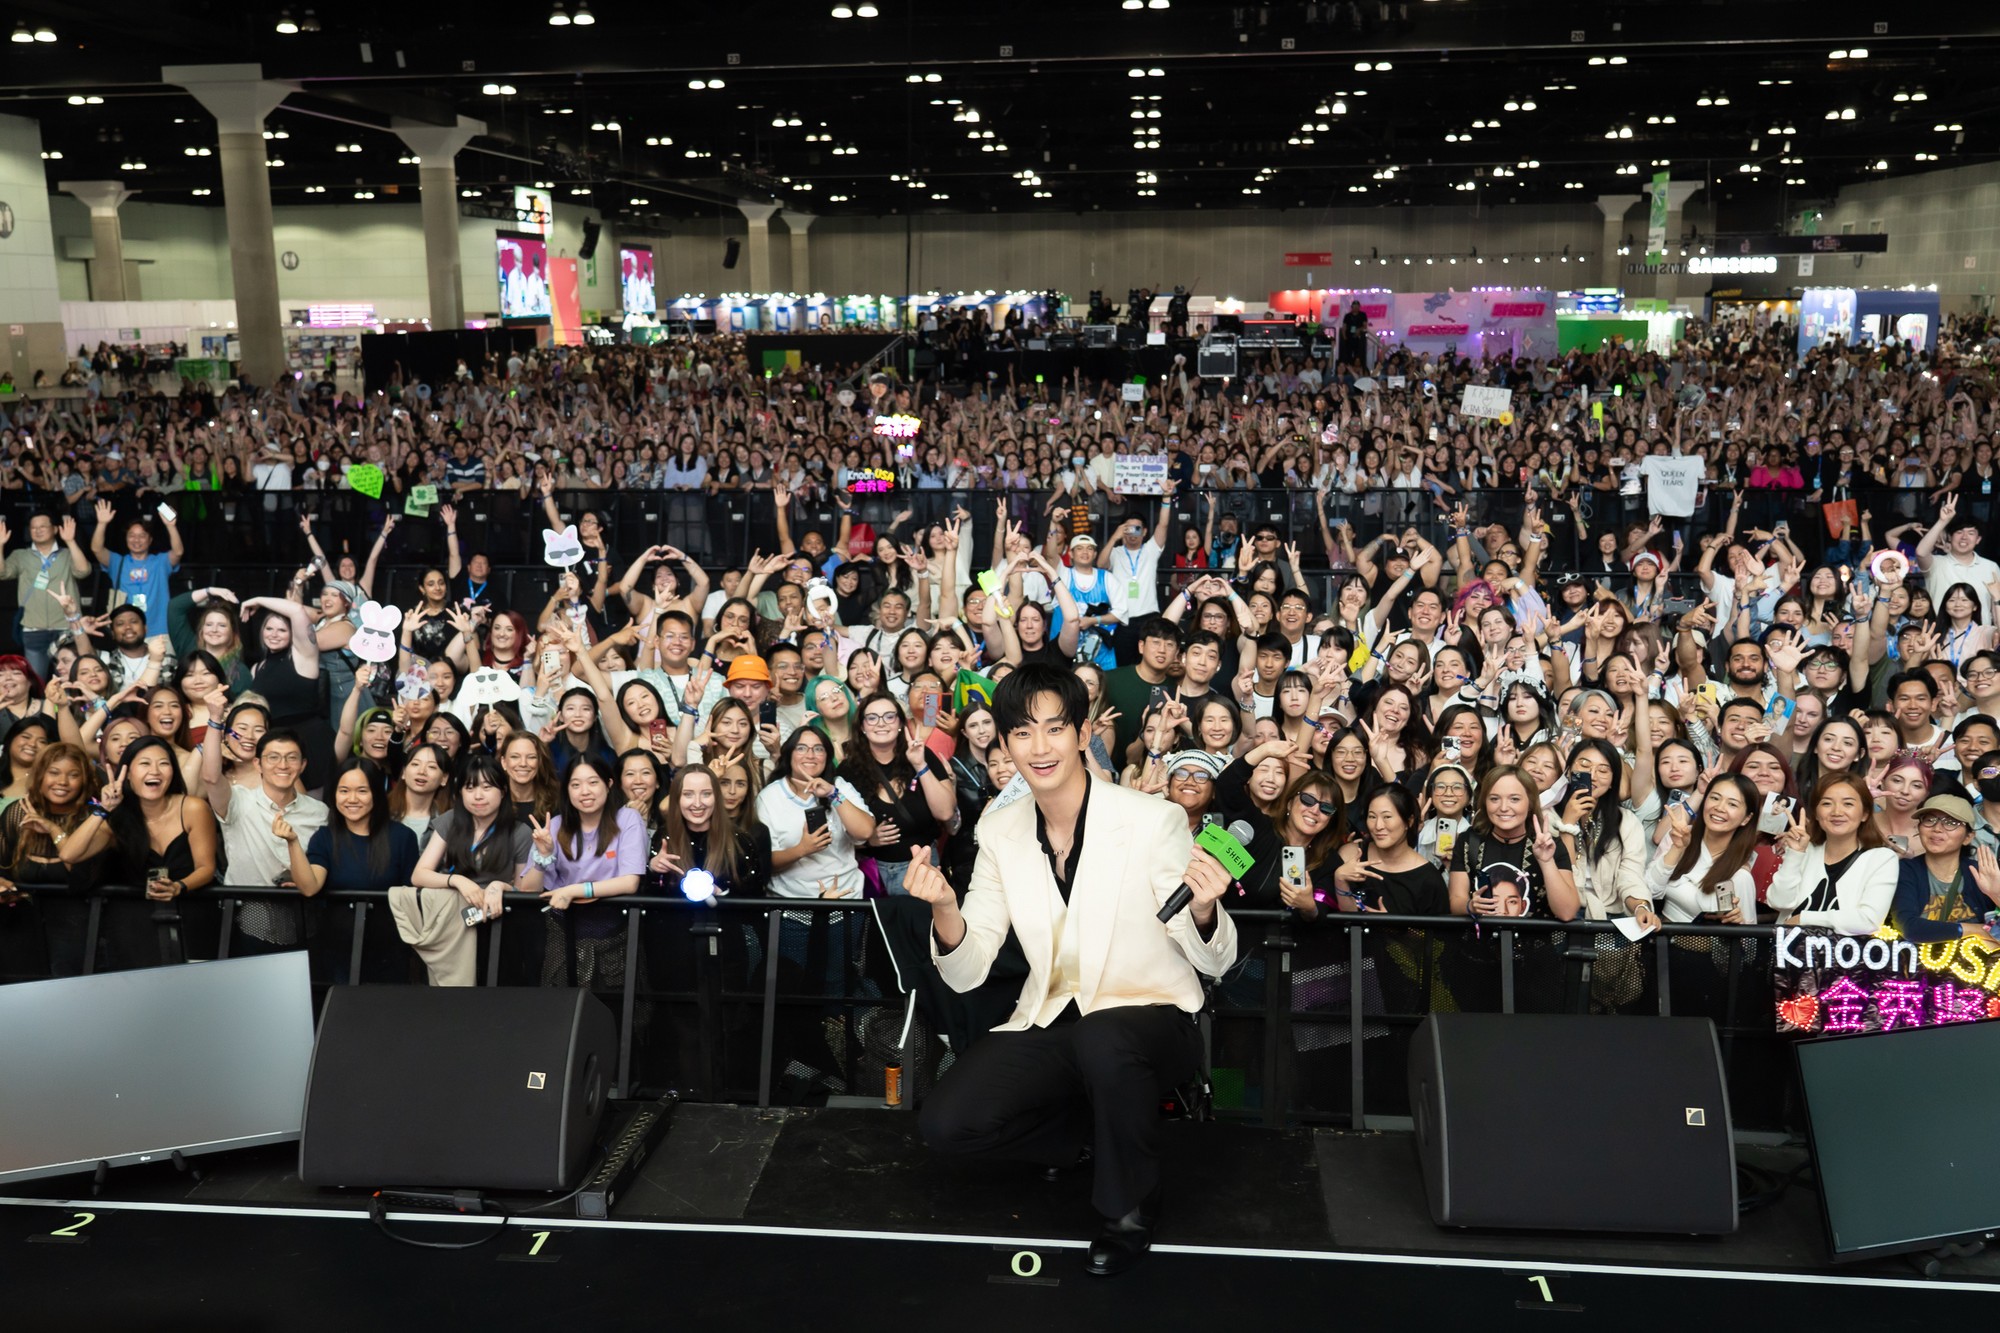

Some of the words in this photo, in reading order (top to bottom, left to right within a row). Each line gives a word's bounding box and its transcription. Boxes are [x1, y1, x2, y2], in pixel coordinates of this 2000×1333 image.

[1688, 257, 1778, 274] SAMSUNG
[874, 468, 895, 482] USA
[1660, 470, 1686, 478] QUEEN
[1662, 479, 1684, 487] TEARS
[1225, 847, 1247, 870] SHEIN
[1776, 926, 1917, 974] Kmoon
[50, 1212, 95, 1238] 2
[528, 1231, 551, 1256] 1
[1527, 1274, 1554, 1302] 1
